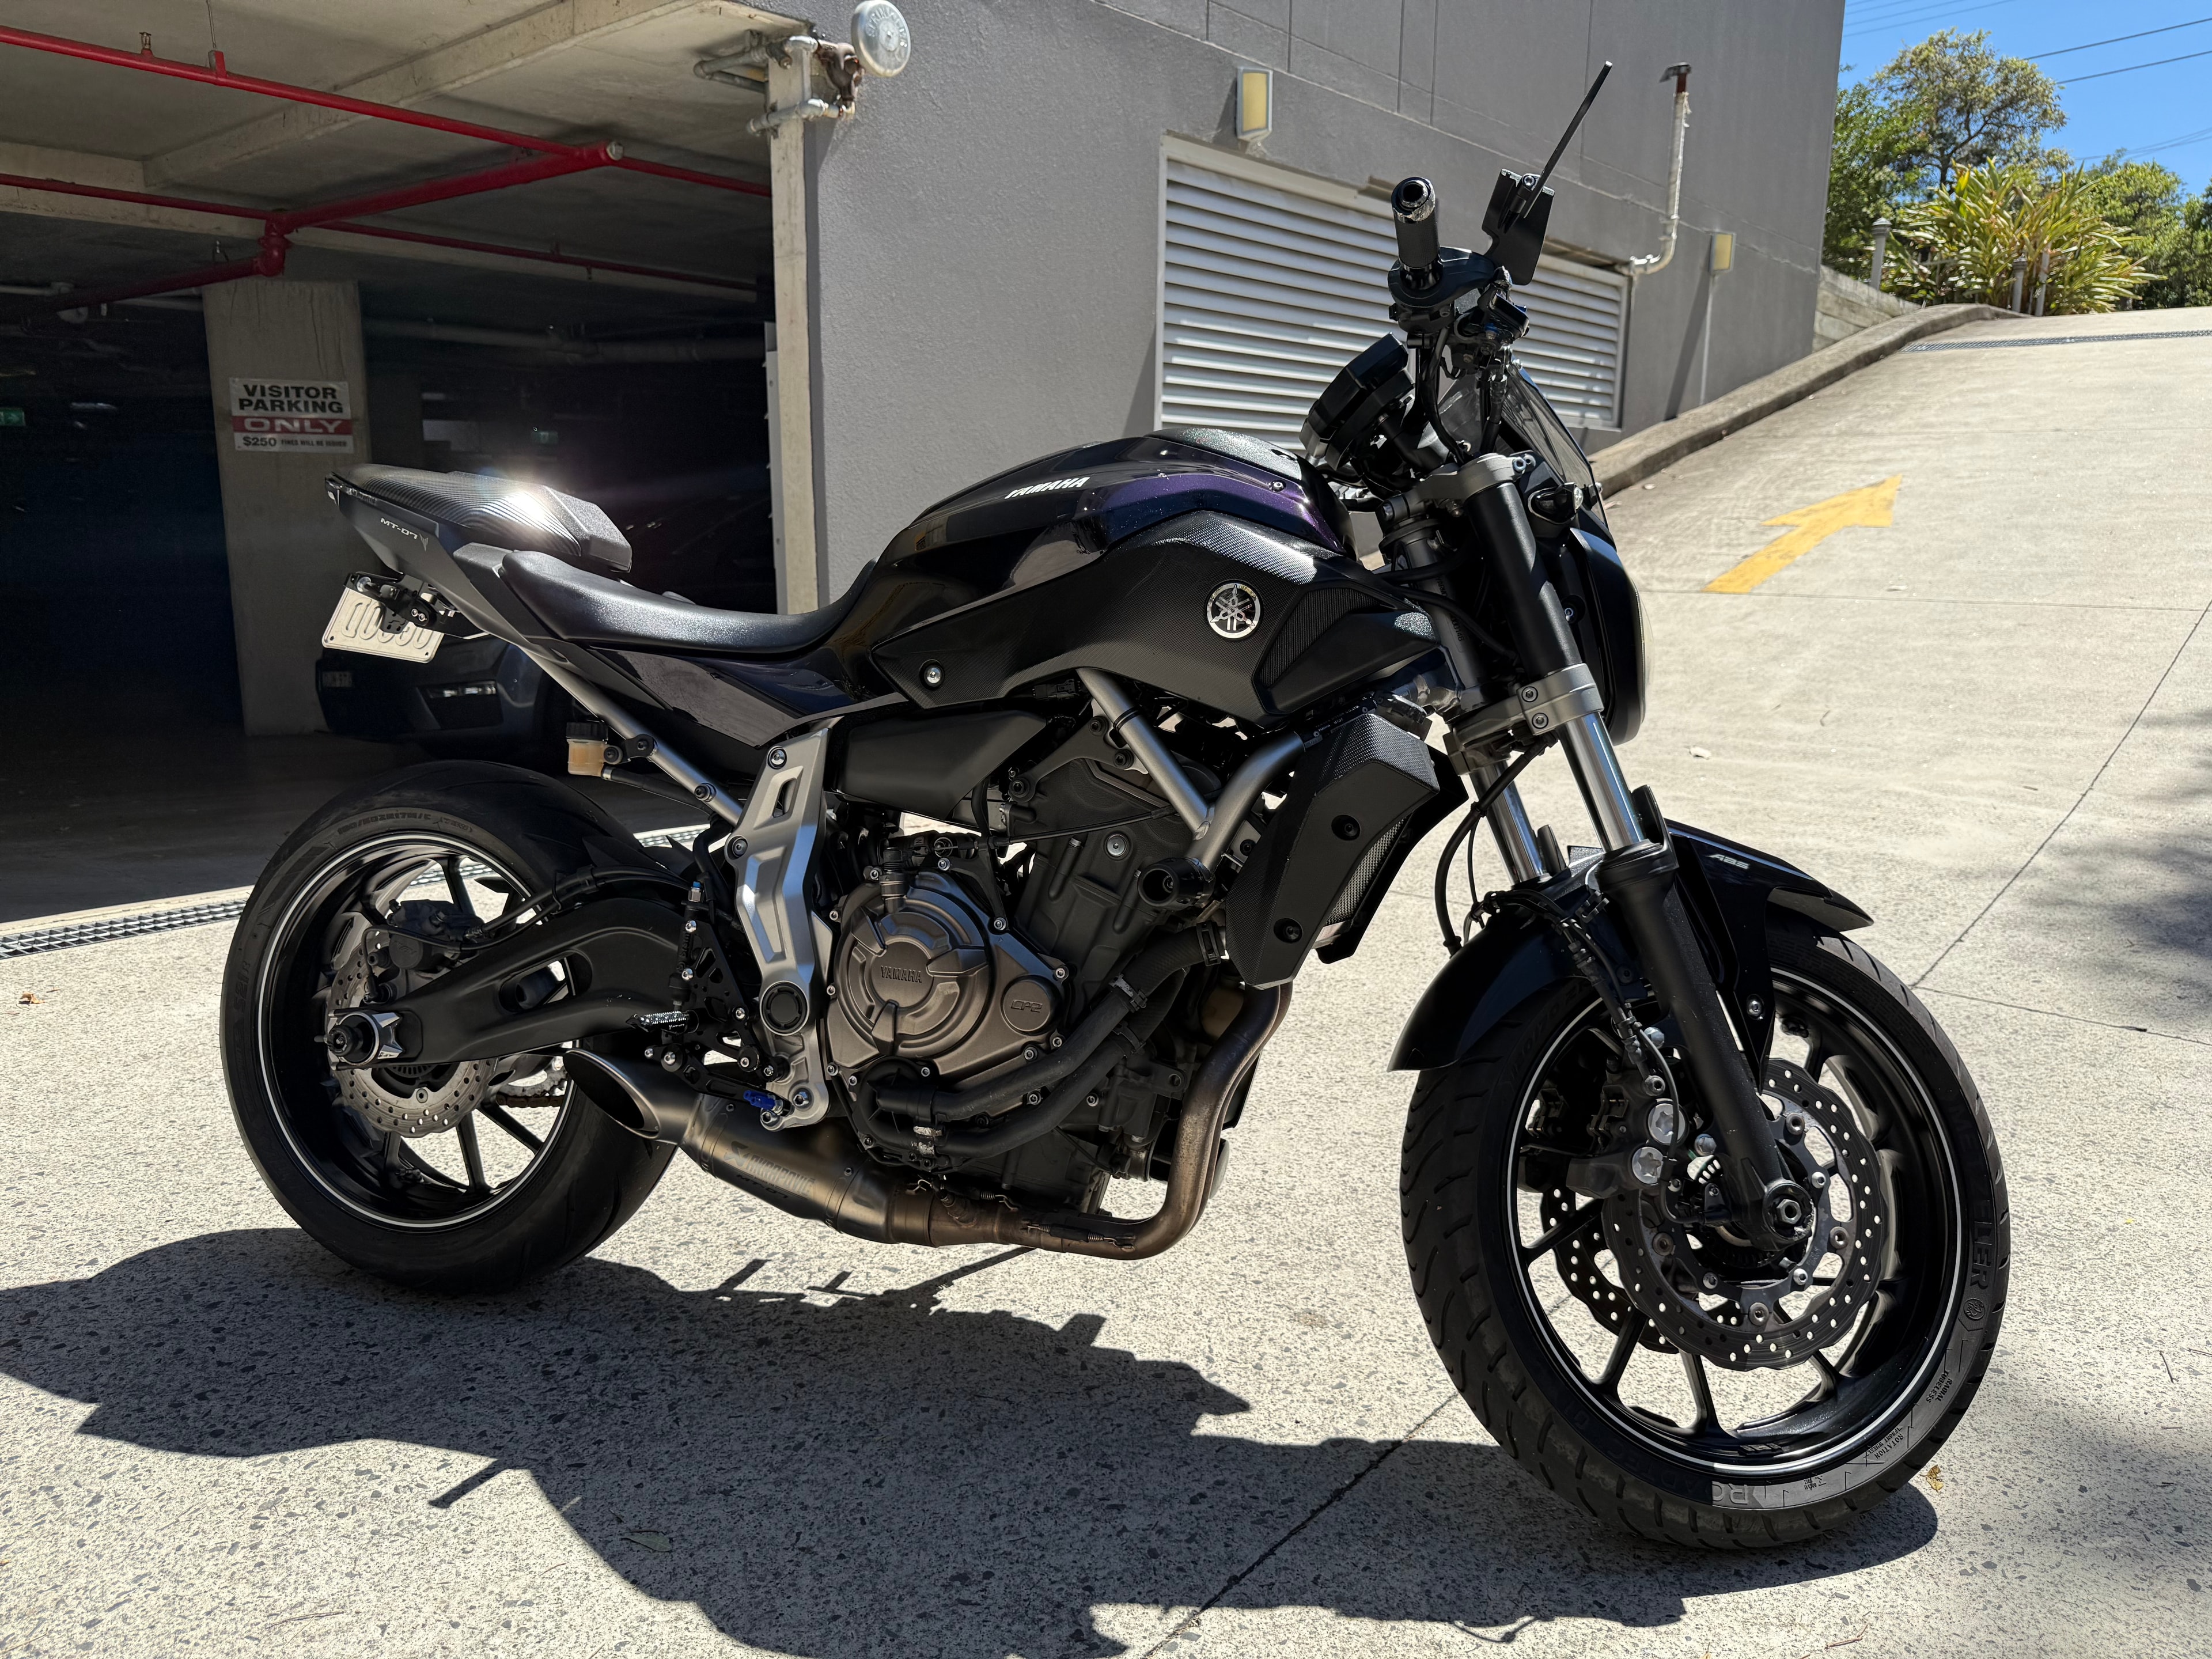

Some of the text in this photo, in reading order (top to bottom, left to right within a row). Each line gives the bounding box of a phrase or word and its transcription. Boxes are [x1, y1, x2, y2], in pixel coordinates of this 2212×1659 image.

[243, 384, 337, 399] VISITOR
[238, 398, 343, 414] PARKING
[244, 418, 342, 433] ONLY
[243, 436, 276, 446] $250
[1004, 476, 1090, 499] YAMAHA
[380, 517, 418, 540] MT-07
[1705, 854, 1749, 869] ABS
[880, 965, 923, 984] YAMAHA
[736, 1174, 788, 1198] MT-07
[1925, 1370, 1949, 1403] TUBELESS
[1935, 1378, 1953, 1401] RADIAL
[1874, 1433, 1903, 1459] ROTATION
